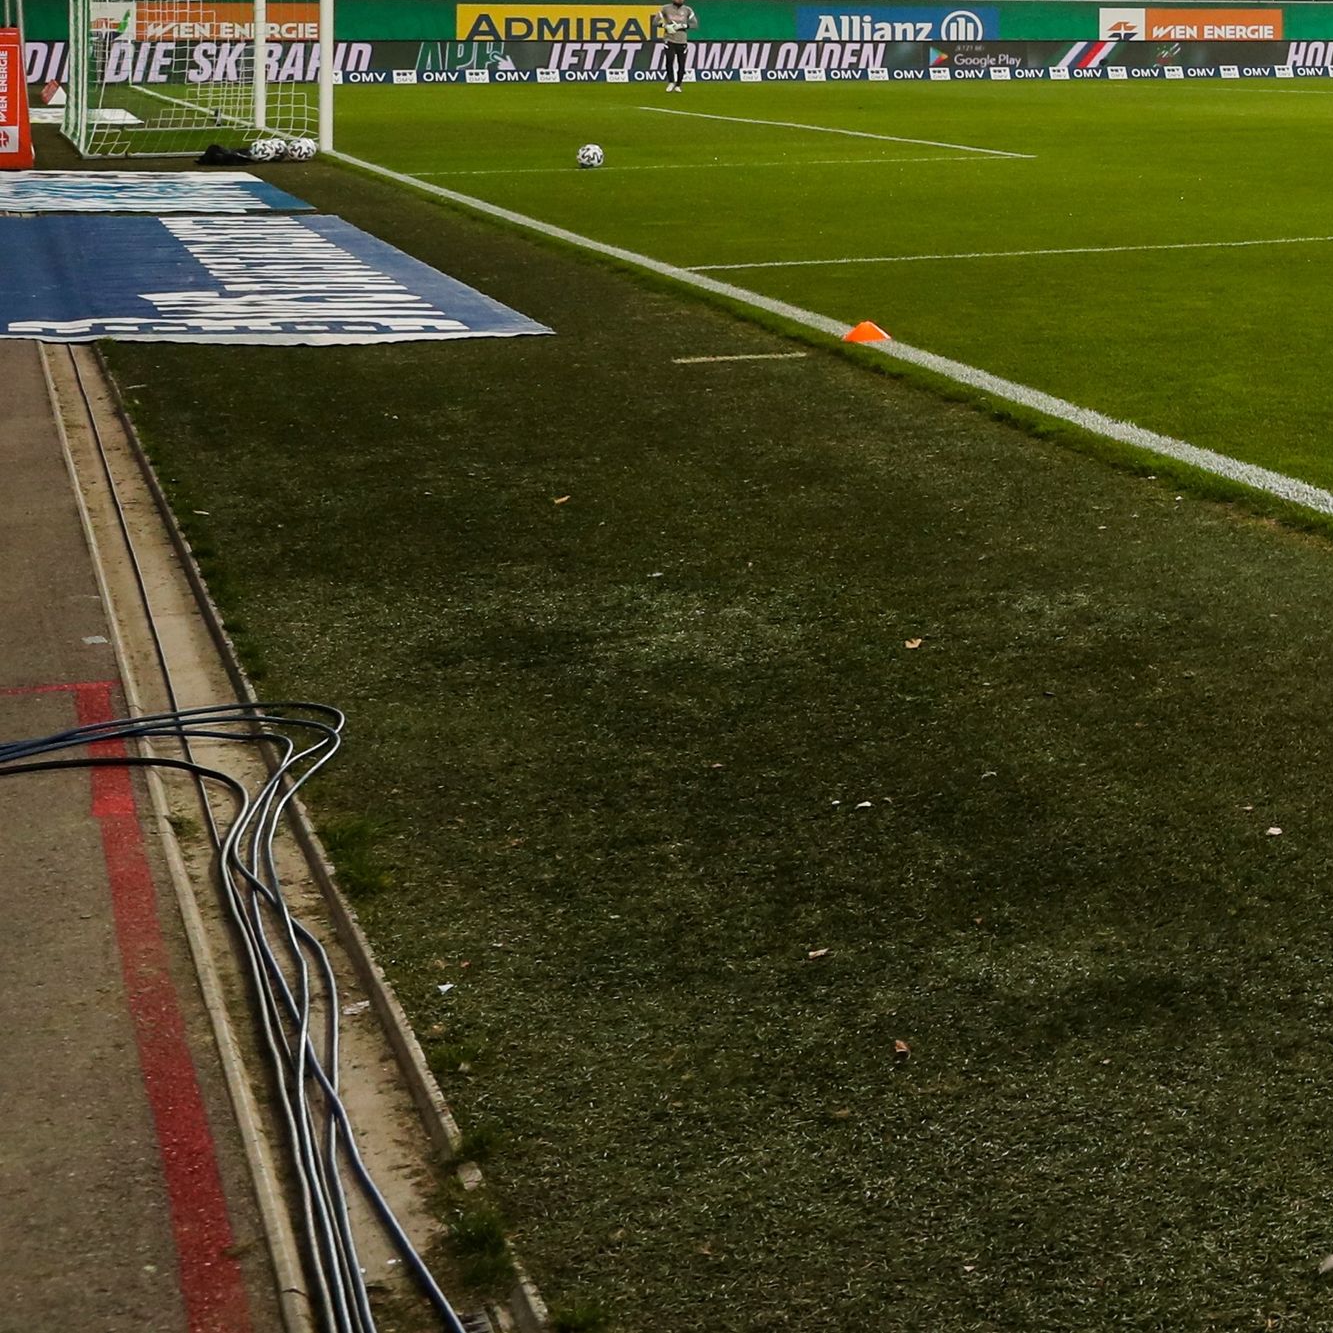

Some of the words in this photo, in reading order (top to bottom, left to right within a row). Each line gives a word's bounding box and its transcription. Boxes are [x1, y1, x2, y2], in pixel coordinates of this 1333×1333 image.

[146, 22, 221, 40] WIEN
[465, 13, 664, 41] ADMIRAL
[814, 14, 934, 41] Allianz
[1152, 25, 1198, 39] WIEN
[1203, 25, 1274, 40] ENERGIE
[954, 53, 996, 68] Google
[998, 54, 1021, 68] Play
[350, 72, 385, 83] OMV
[423, 71, 459, 82] OMV
[495, 71, 530, 82] OMV
[565, 70, 599, 81] OMV
[634, 70, 667, 81] OMV
[701, 70, 733, 80] OMV
[766, 70, 798, 80] OMV
[830, 69, 862, 80] OMV
[893, 69, 924, 79] OMV
[954, 68, 985, 79] OMV
[1015, 68, 1044, 78] OMV
[1073, 68, 1103, 78] OMV
[1131, 68, 1160, 77] OMV
